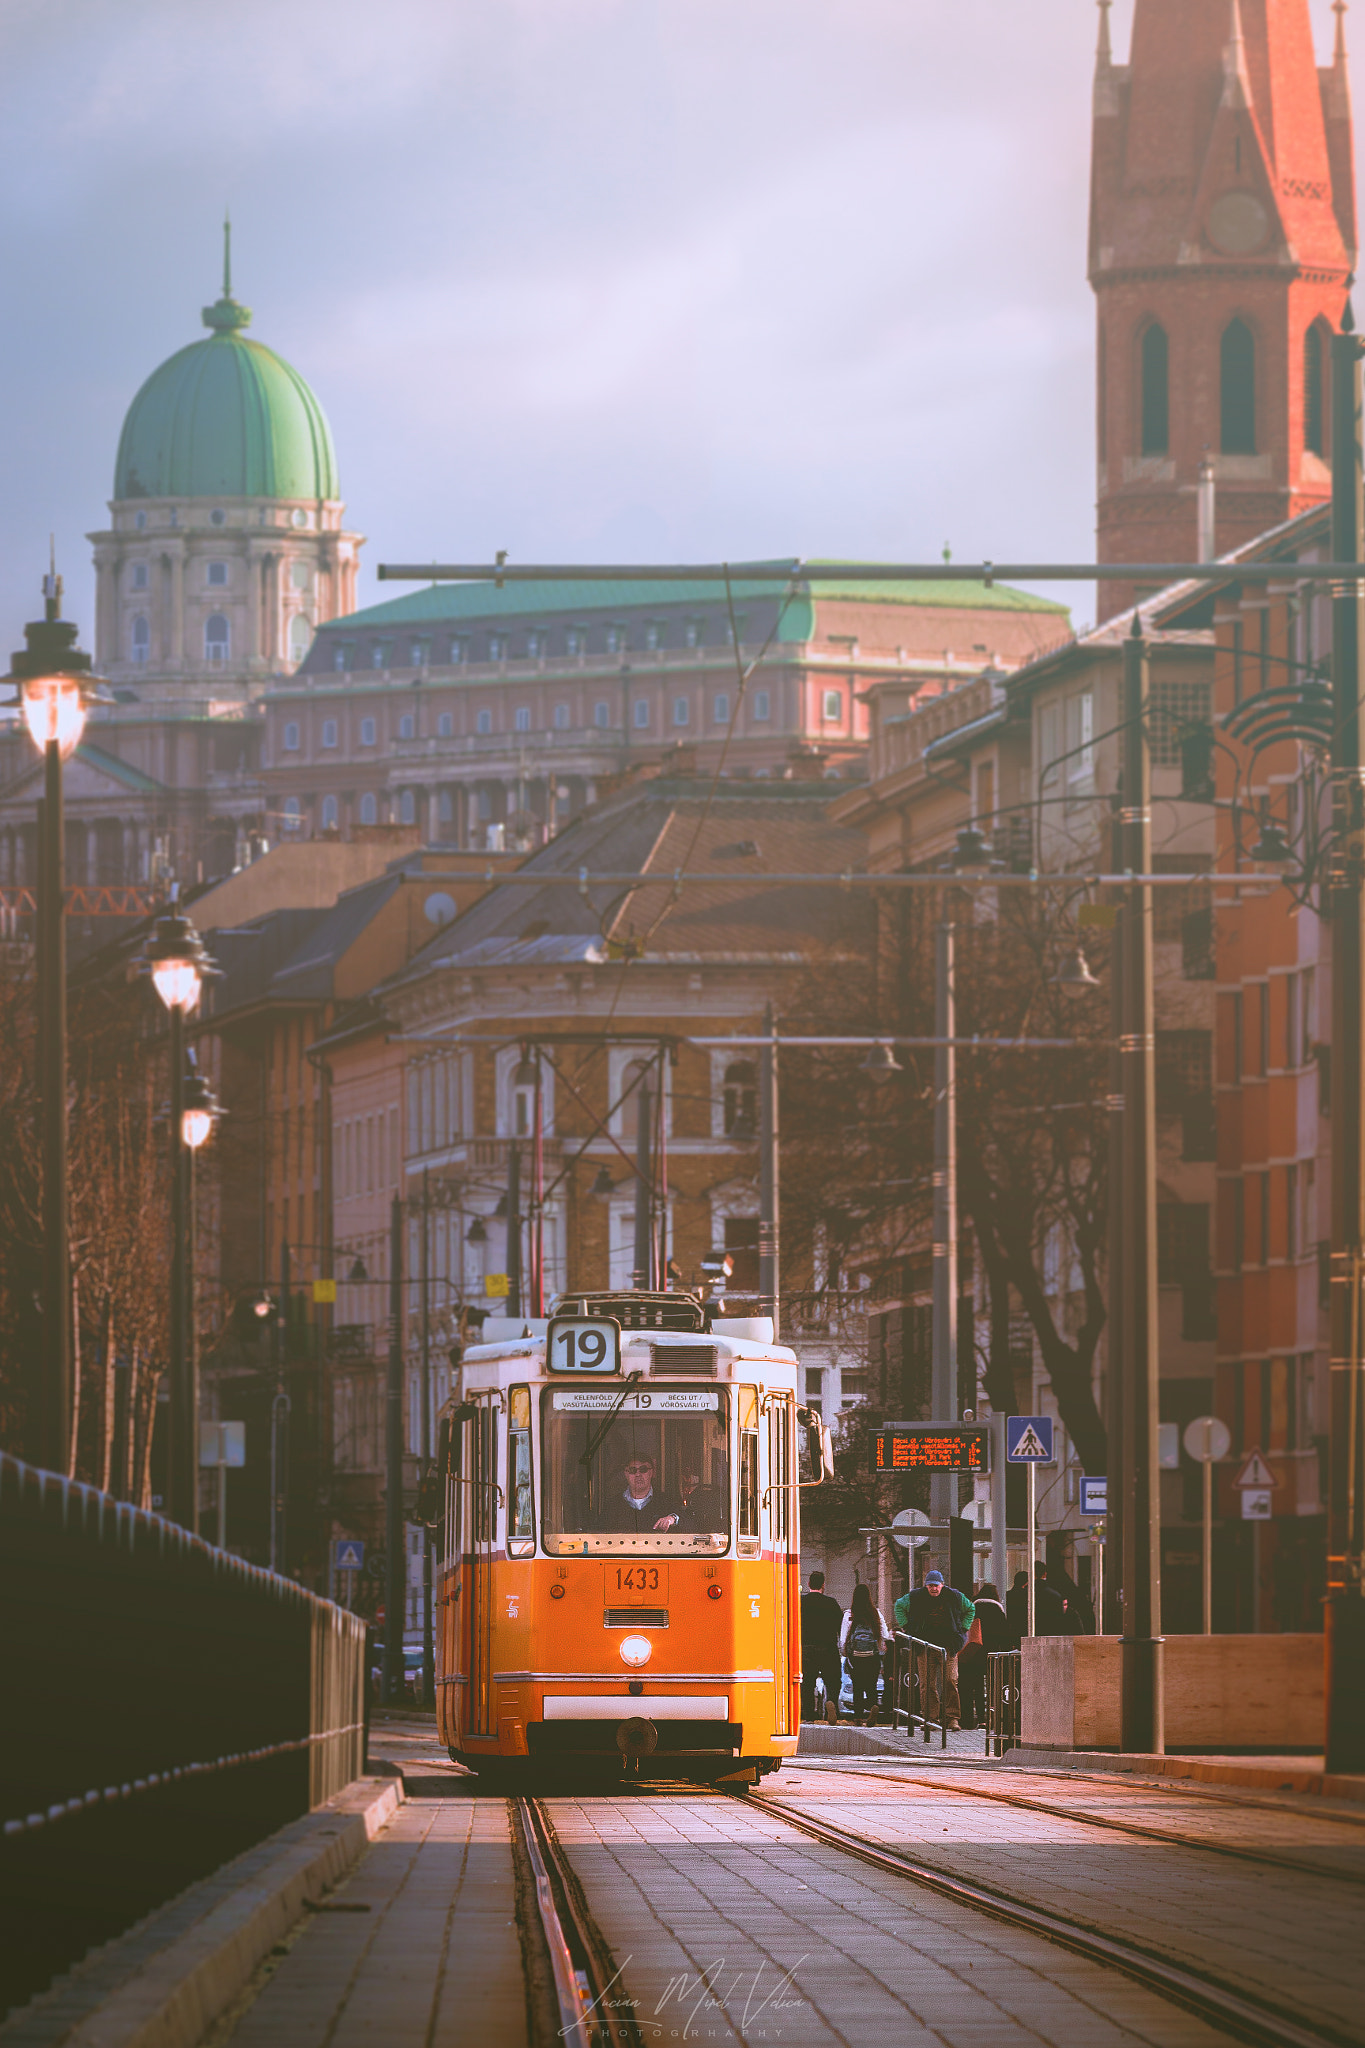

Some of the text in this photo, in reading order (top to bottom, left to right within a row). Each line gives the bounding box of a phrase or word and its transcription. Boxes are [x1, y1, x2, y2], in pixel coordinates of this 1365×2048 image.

[557, 1330, 607, 1368] 19
[633, 1394, 652, 1409] 19
[688, 1393, 697, 1401] ÚT
[616, 1567, 659, 1590] 1433
